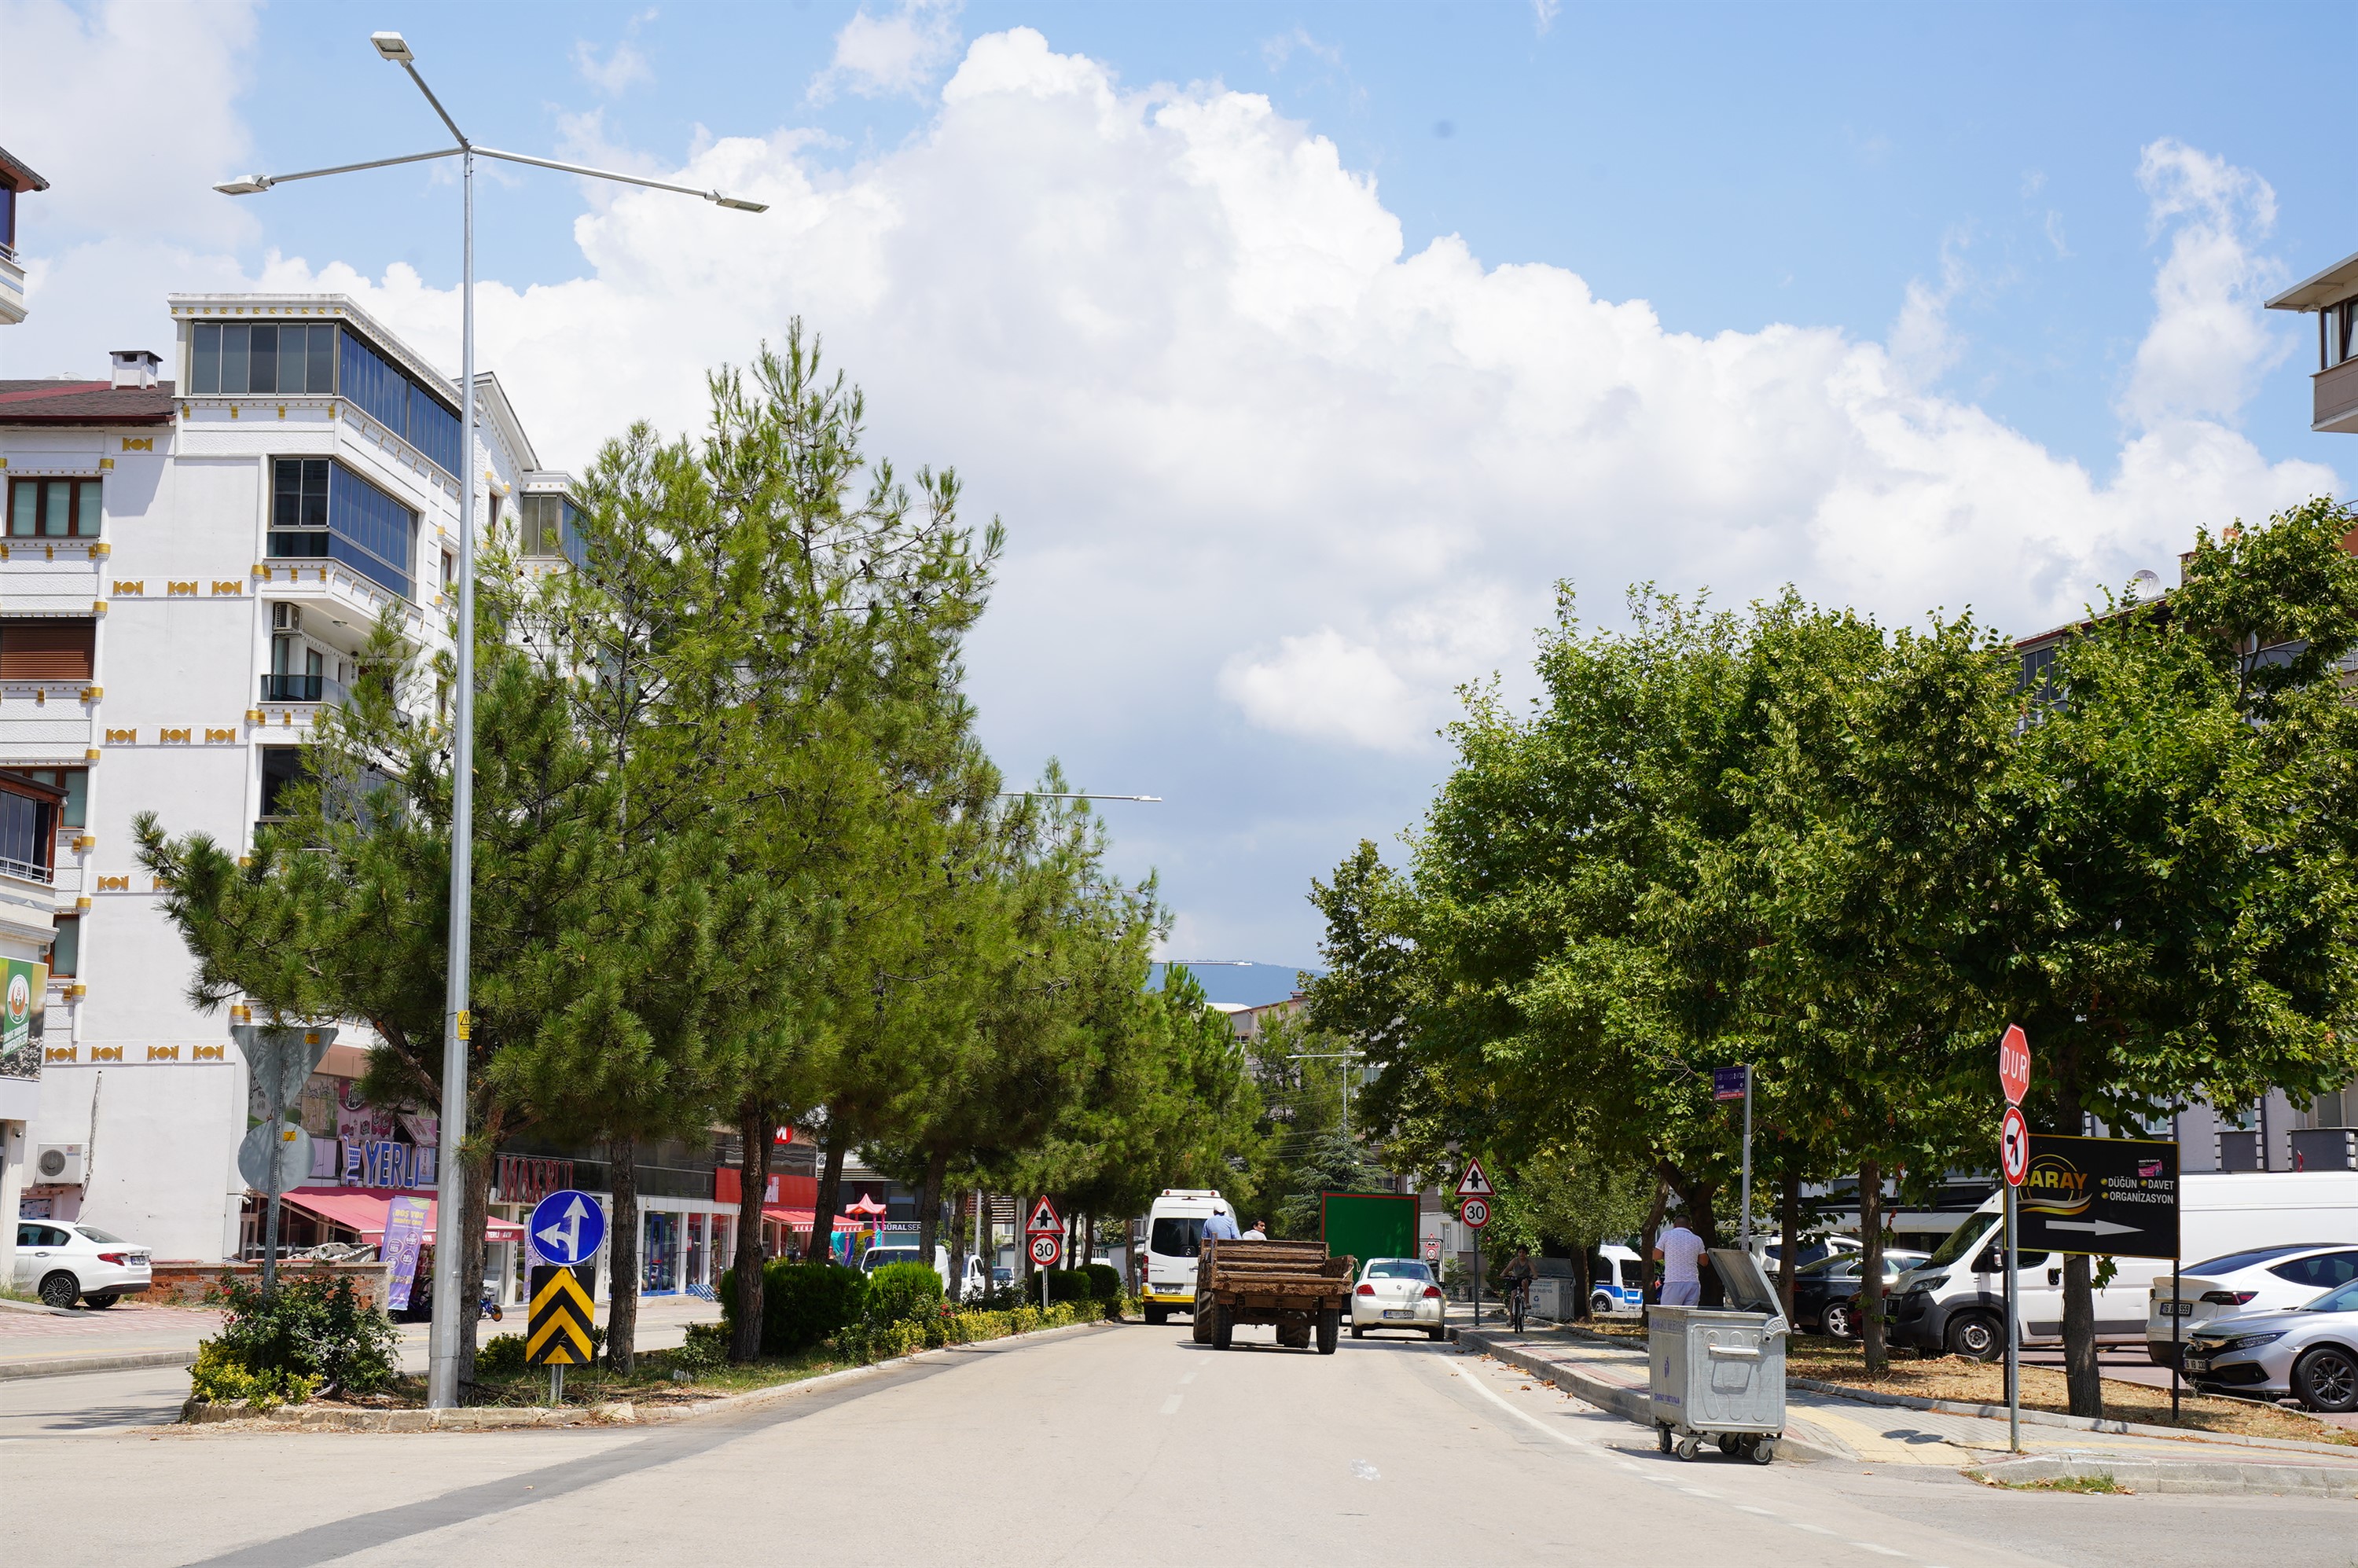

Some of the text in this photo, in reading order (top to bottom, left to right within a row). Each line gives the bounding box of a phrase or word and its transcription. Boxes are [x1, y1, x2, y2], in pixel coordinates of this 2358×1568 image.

[2003, 1046, 2026, 1084] DUR
[365, 1140, 421, 1188] YERLİ
[2108, 1176, 2174, 1190] DÜĞÜN DAVET
[2110, 1191, 2174, 1204] ORGANİZASYON
[1467, 1206, 1485, 1220] 30
[1035, 1243, 1054, 1257] 30
